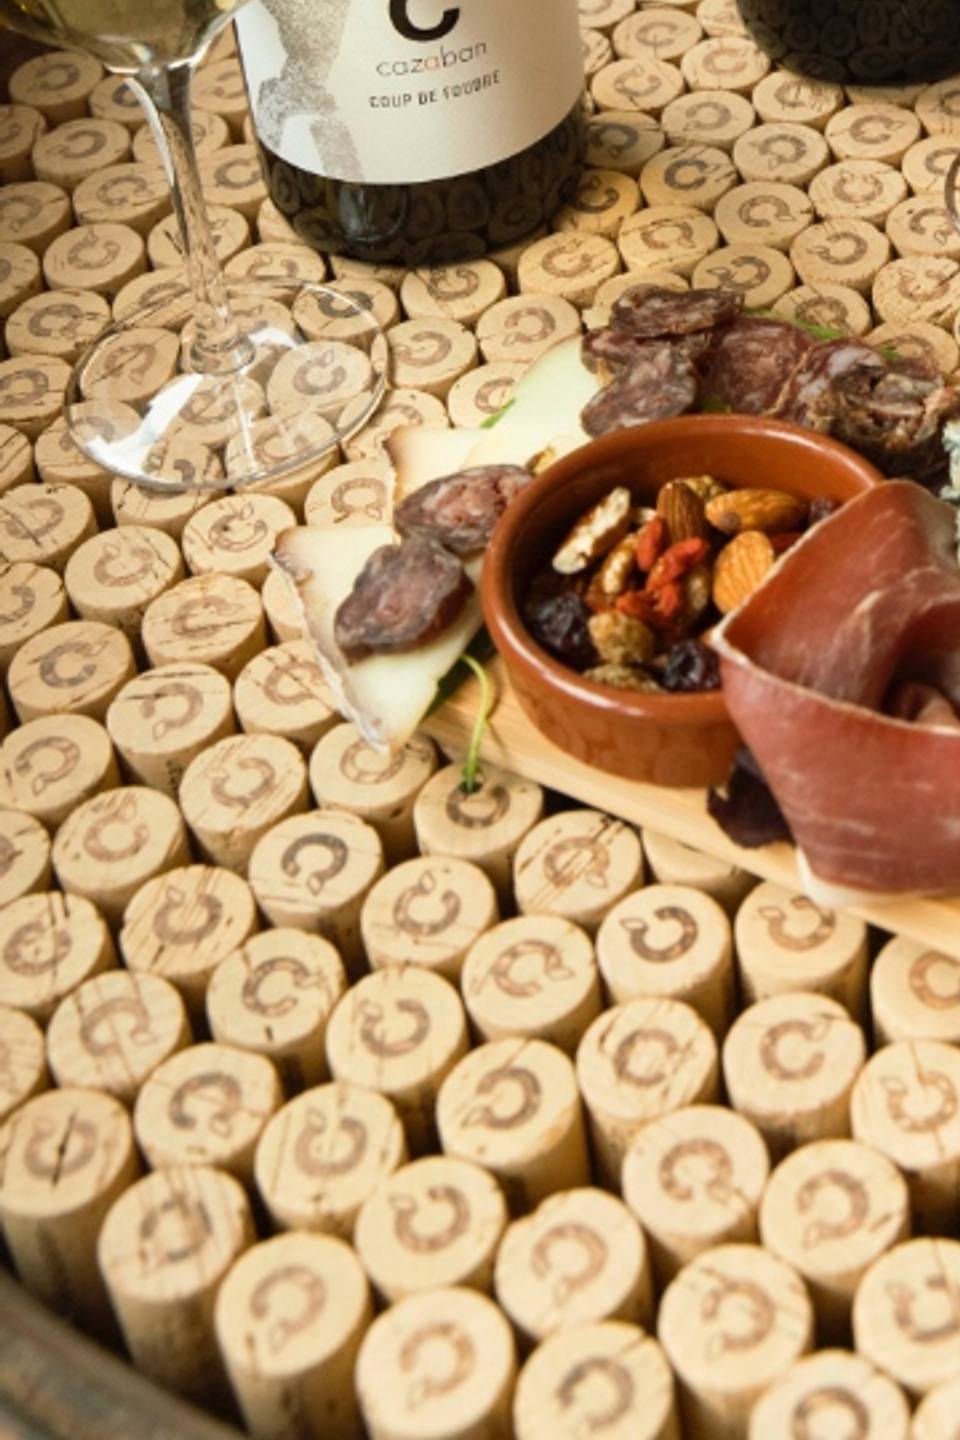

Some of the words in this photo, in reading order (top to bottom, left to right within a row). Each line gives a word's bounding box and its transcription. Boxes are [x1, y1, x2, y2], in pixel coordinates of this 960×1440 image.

[376, 42, 488, 77] cazaban
[369, 93, 412, 108] COUP
[418, 90, 438, 105] DE
[442, 69, 500, 100] FOUDRE
